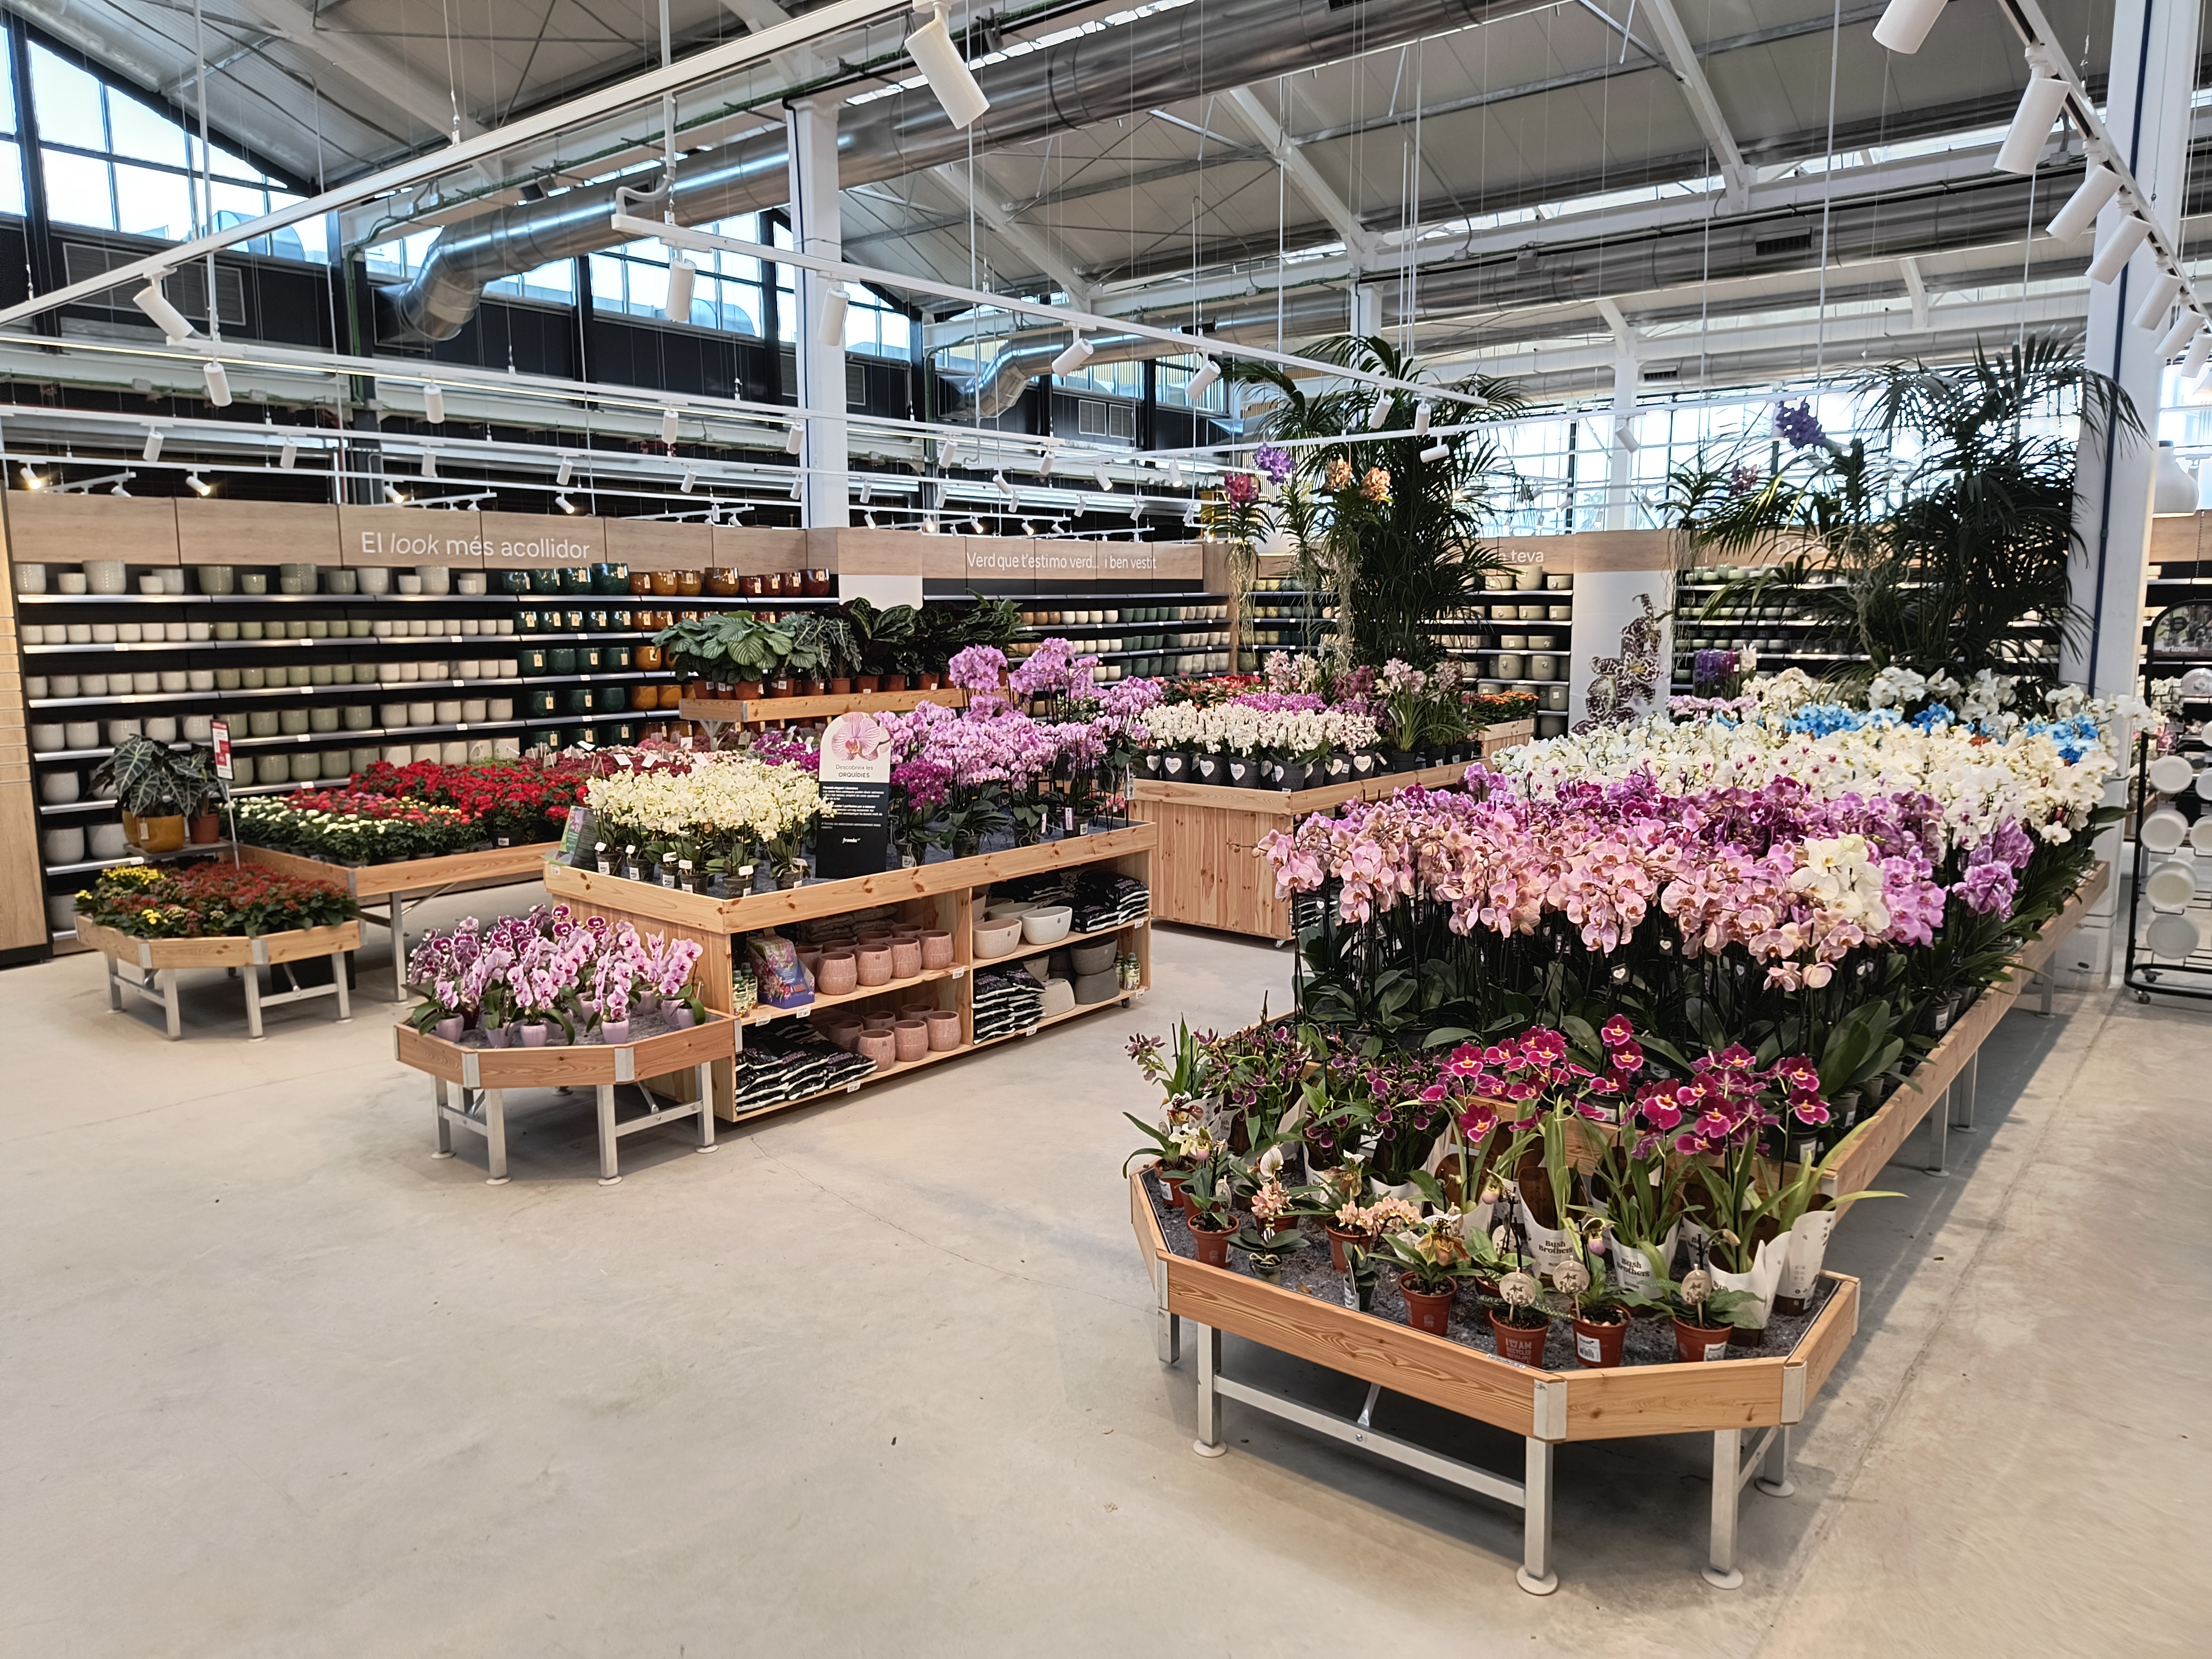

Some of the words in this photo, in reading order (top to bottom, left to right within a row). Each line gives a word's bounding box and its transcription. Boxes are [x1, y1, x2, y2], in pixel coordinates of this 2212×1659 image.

[361, 531, 382, 554] El
[390, 532, 439, 555] look
[446, 532, 494, 556] més
[501, 538, 590, 558] acollidor
[967, 552, 995, 568] Verd
[997, 556, 1019, 571] que
[1104, 555, 1108, 568] i
[1110, 555, 1128, 569] ben
[1130, 556, 1157, 569] vestit
[1510, 549, 1544, 563] teva
[1539, 1244, 1573, 1254] Brothers
[1622, 1258, 1641, 1269] Bush
[1518, 1341, 1532, 1350] AM
